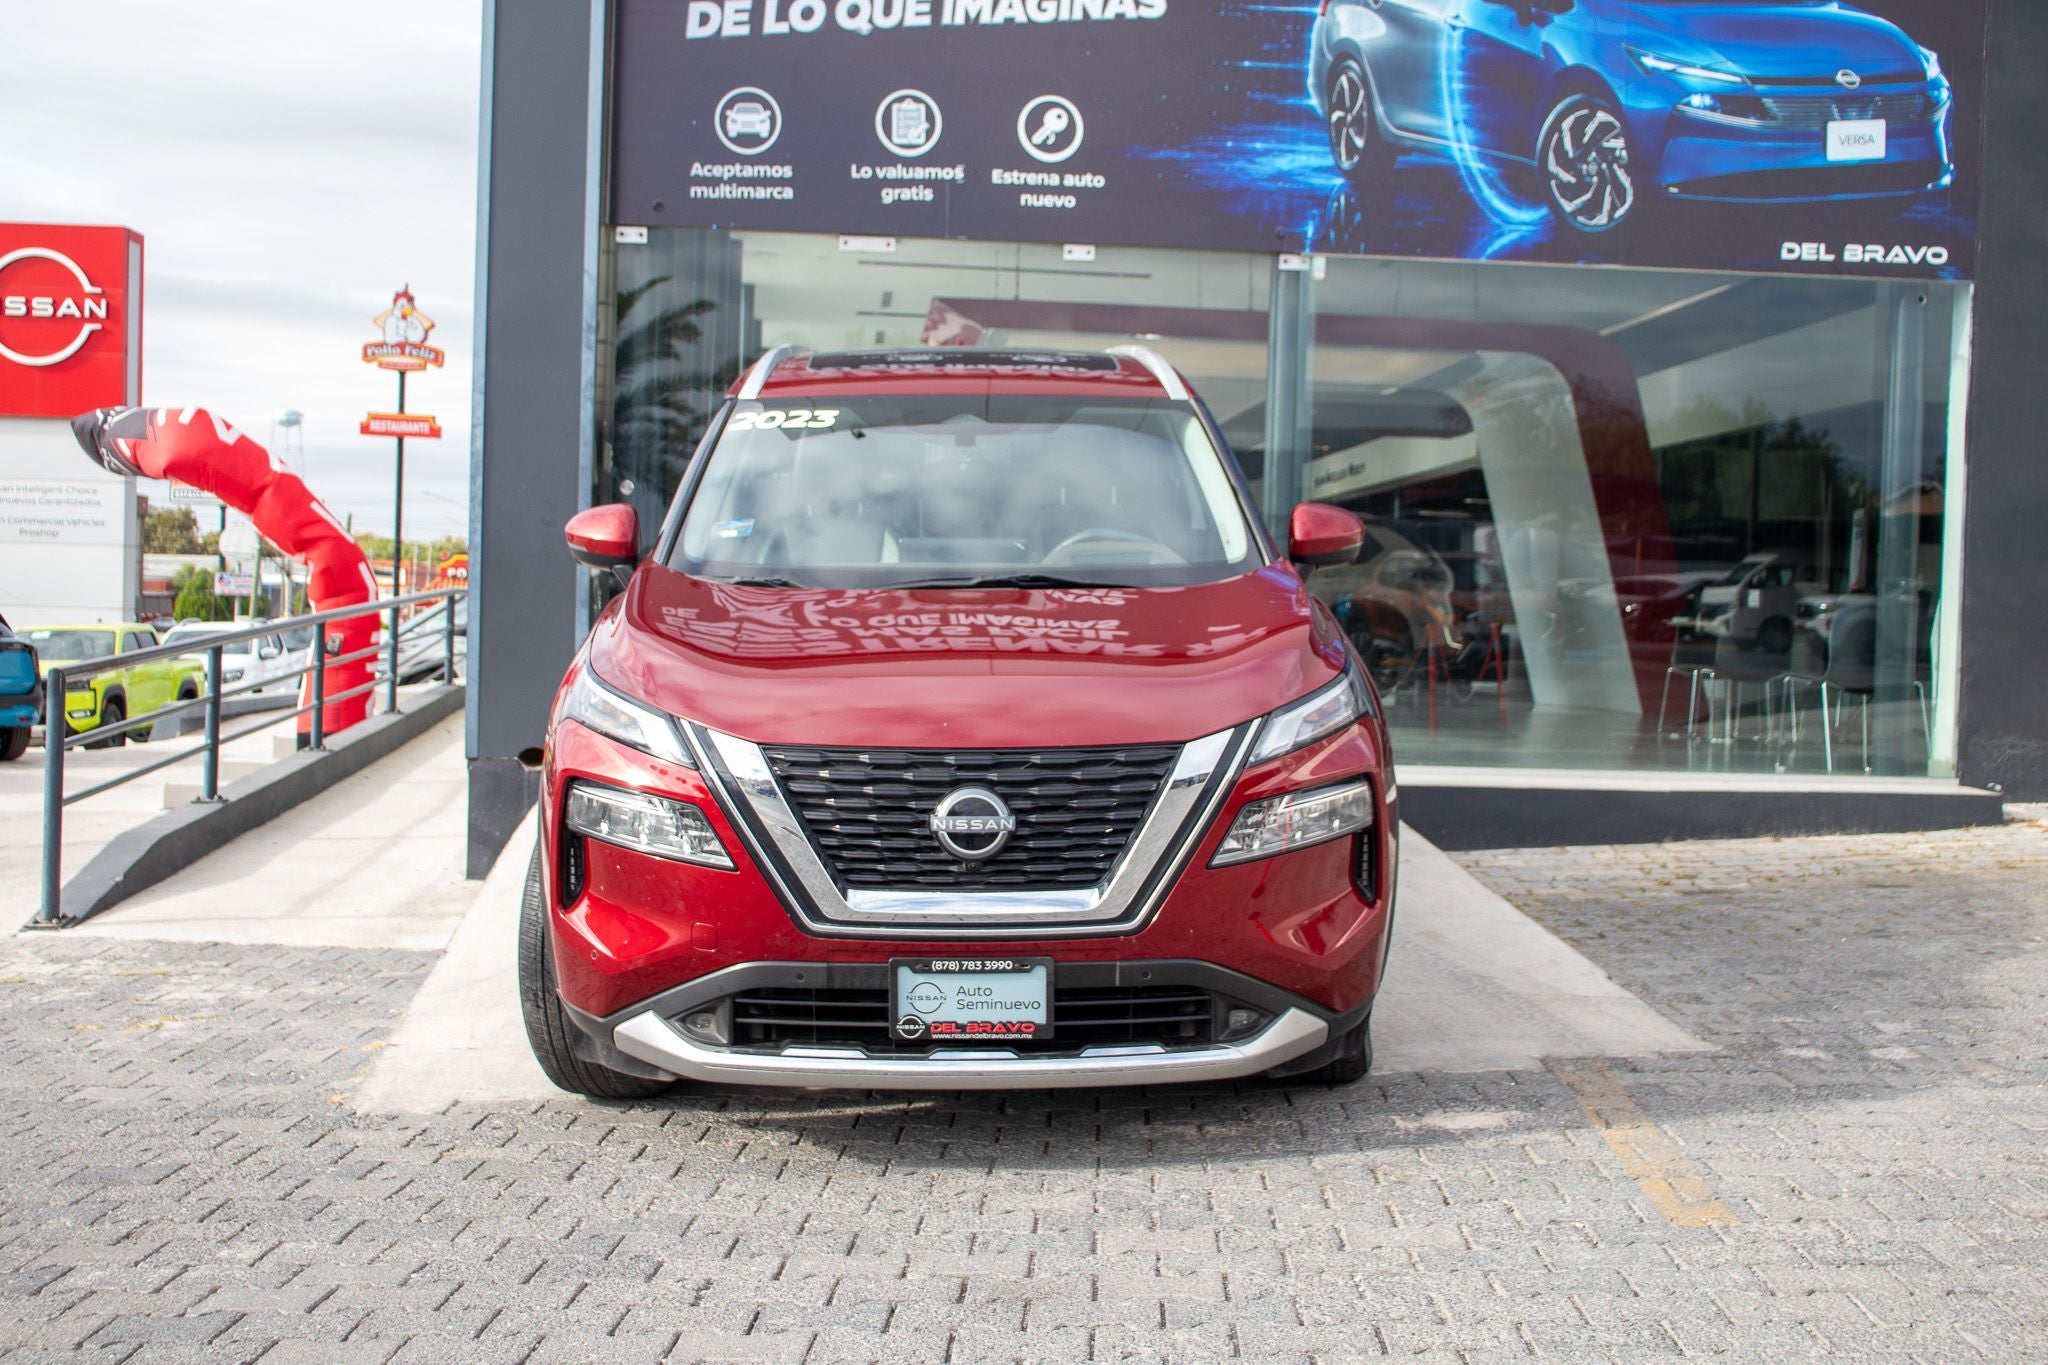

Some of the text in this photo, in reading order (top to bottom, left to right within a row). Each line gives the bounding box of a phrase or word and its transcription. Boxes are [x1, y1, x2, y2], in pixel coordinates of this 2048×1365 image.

[685, 0, 752, 39] DE
[762, 0, 827, 35] LO
[834, 0, 933, 36] QUE
[1838, 133, 1876, 146] VERSA
[690, 162, 793, 180] Aceptamos
[851, 163, 965, 181] Lo valuamos
[991, 168, 1106, 189] Estrena auto
[690, 183, 794, 200] multimarca
[881, 185, 934, 204] gratis
[1020, 193, 1077, 209] nuevo
[1780, 241, 1949, 266] DEL BRAVO
[4, 295, 107, 319] SSAN
[369, 418, 431, 435] RESTAURANTE
[727, 409, 840, 431] 2023
[16, 484, 62, 495] Intelligent
[65, 485, 98, 494] Choice
[39, 496, 102, 507] Garantizados
[7, 515, 64, 525] Commercial
[66, 517, 105, 527] Vehicles
[19, 527, 60, 538] Proshop
[933, 818, 1013, 830] NISSAN
[931, 960, 1013, 972] (878) 783 3990
[956, 986, 993, 997] Auto
[956, 999, 1041, 1010] Seminuevo
[930, 1022, 1036, 1033] DEL BRAVO
